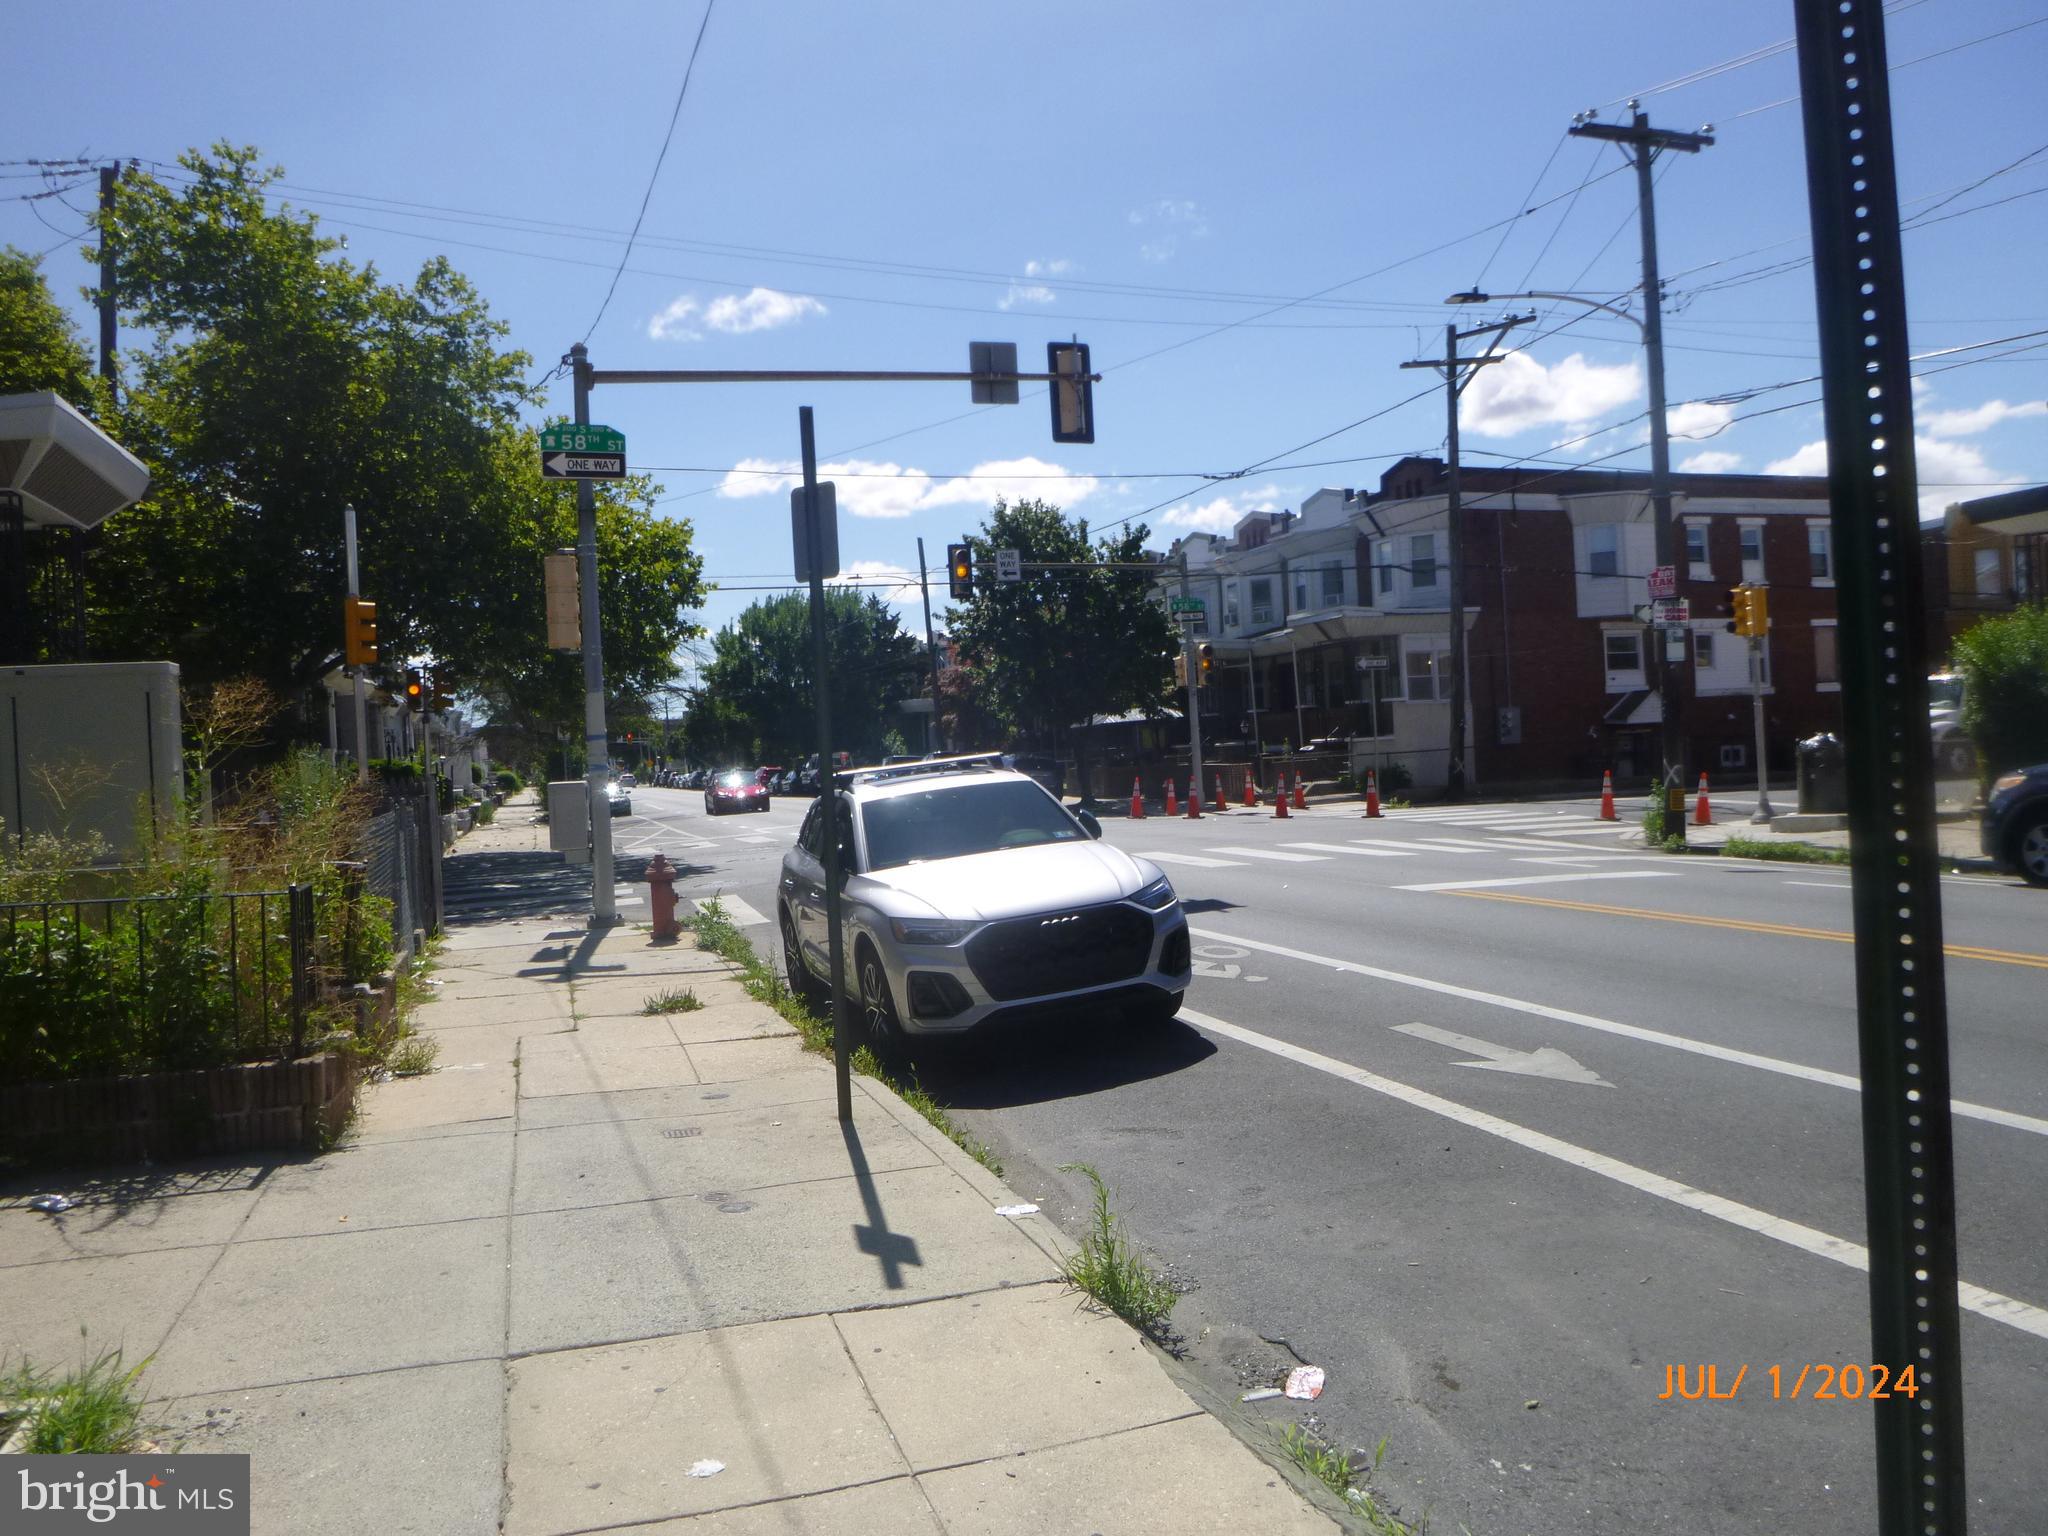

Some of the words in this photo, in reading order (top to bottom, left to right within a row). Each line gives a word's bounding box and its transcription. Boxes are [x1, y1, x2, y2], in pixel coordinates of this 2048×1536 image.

[561, 434, 600, 450] 58TH
[607, 440, 624, 451] ST
[567, 460, 590, 471] ONE
[593, 461, 617, 471] WAY
[999, 560, 1016, 568] WAY
